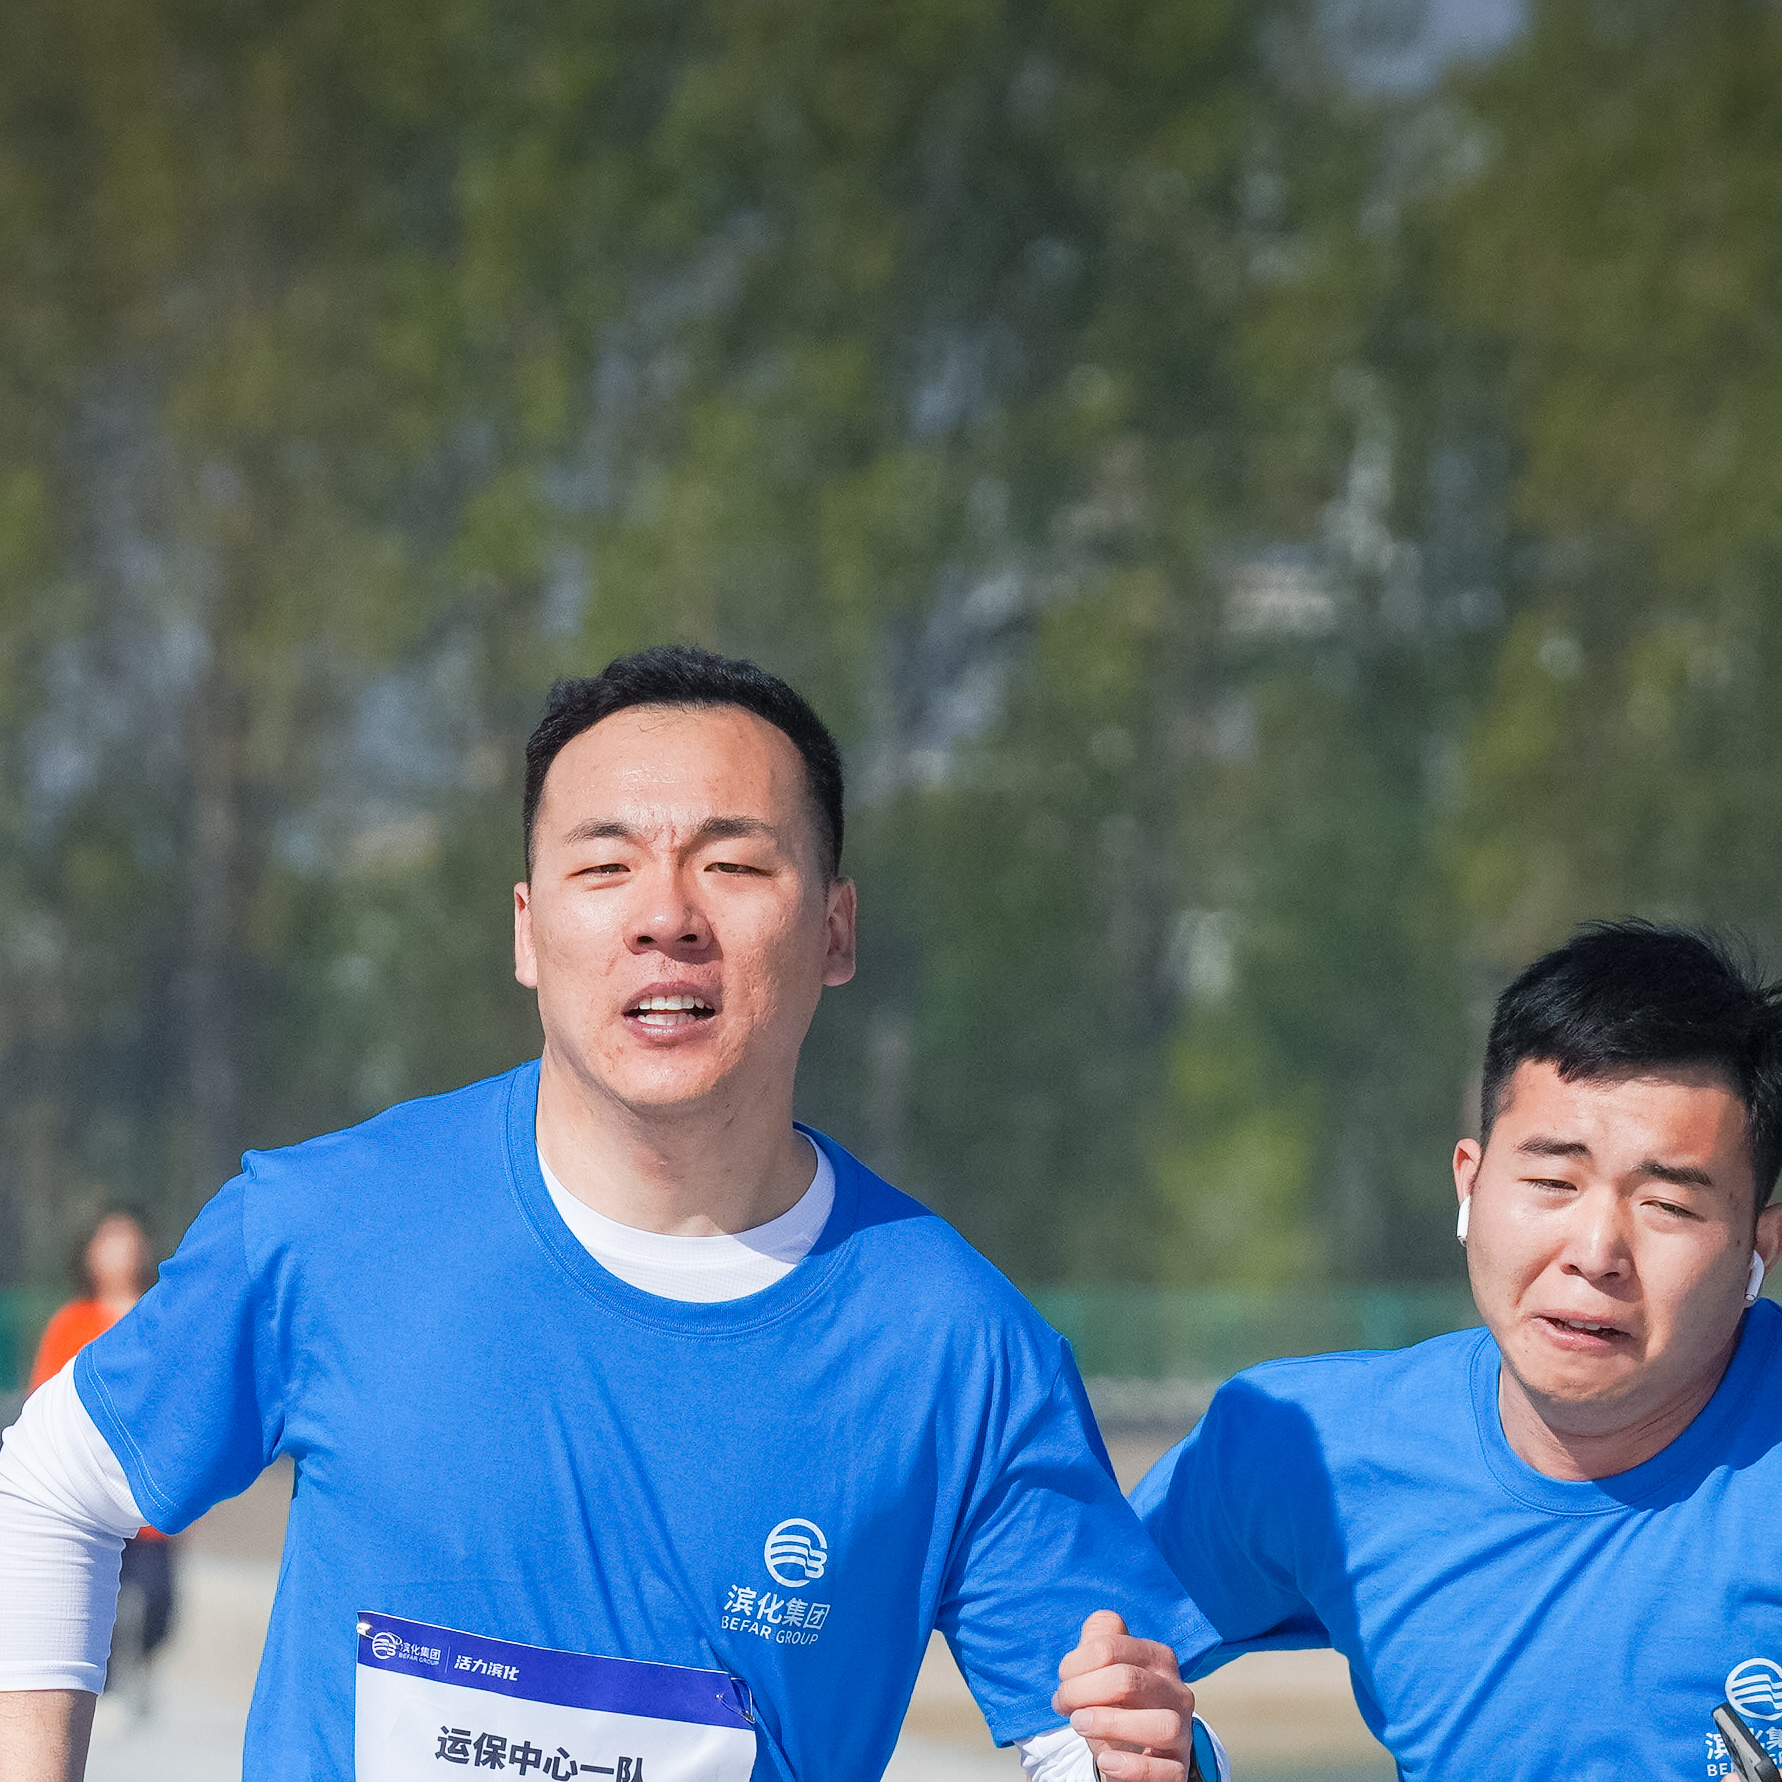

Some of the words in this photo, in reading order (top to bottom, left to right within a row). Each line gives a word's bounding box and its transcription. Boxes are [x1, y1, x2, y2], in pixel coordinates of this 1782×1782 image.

[723, 1584, 831, 1630] 滨化集团
[721, 1615, 772, 1640] BEFAR
[775, 1629, 819, 1645] GROUP
[454, 1654, 520, 1681] 活力滨化
